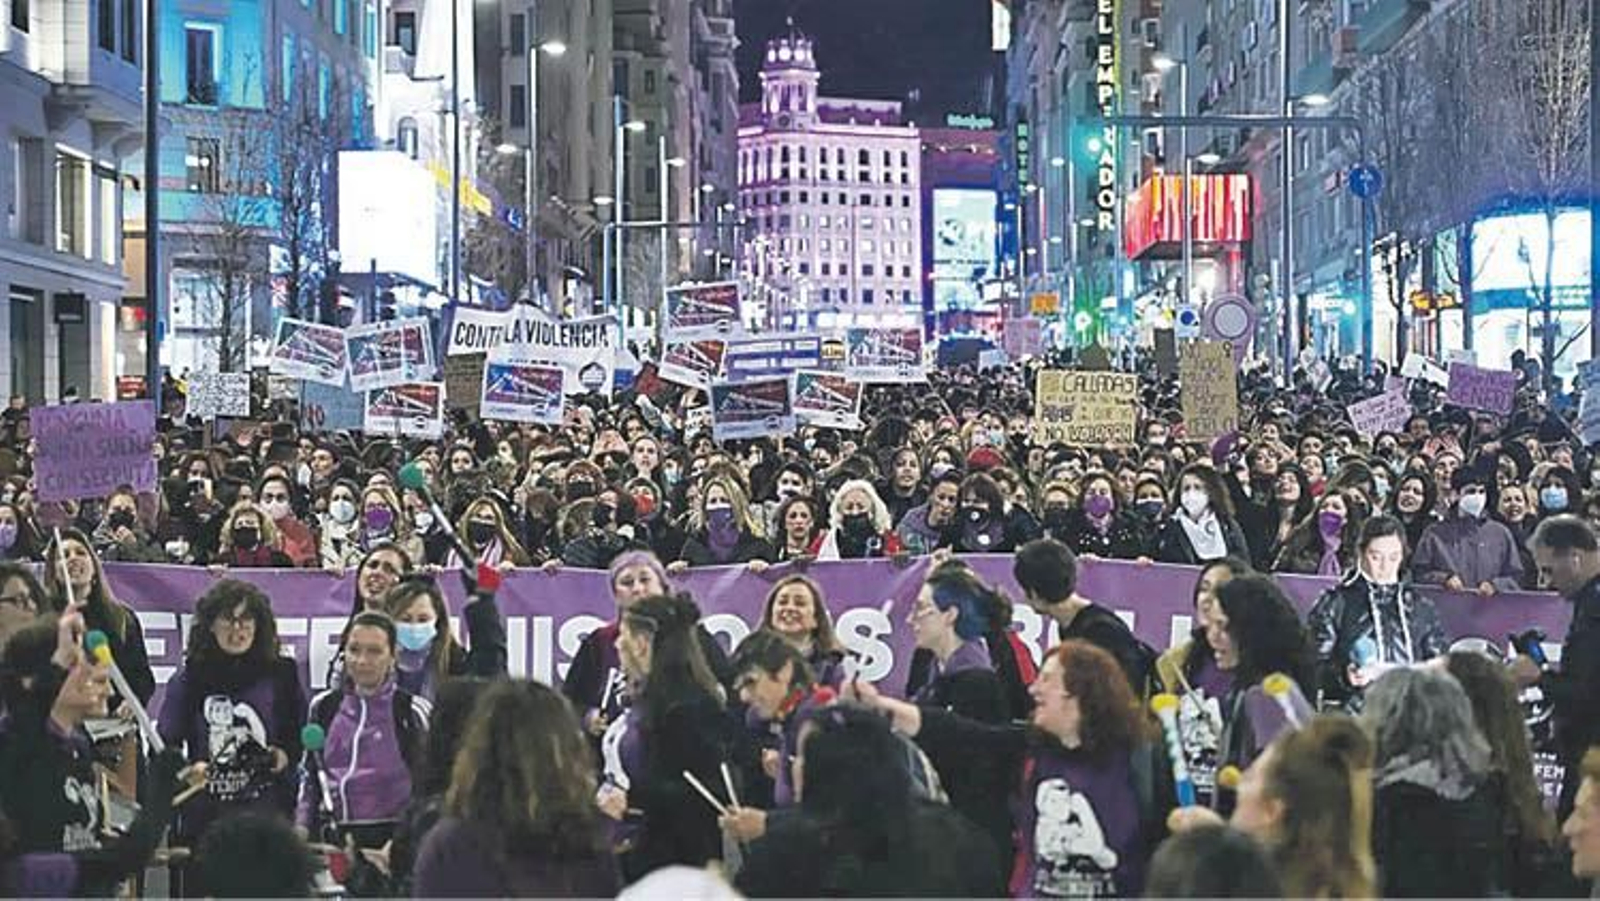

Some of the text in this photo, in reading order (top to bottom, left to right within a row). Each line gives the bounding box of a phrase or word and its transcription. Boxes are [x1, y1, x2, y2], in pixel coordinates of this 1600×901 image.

[1099, 0, 1114, 34] EL
[504, 319, 522, 344] LA
[526, 320, 609, 348] VIOLENCIA
[1063, 373, 1134, 393] CALLADAS
